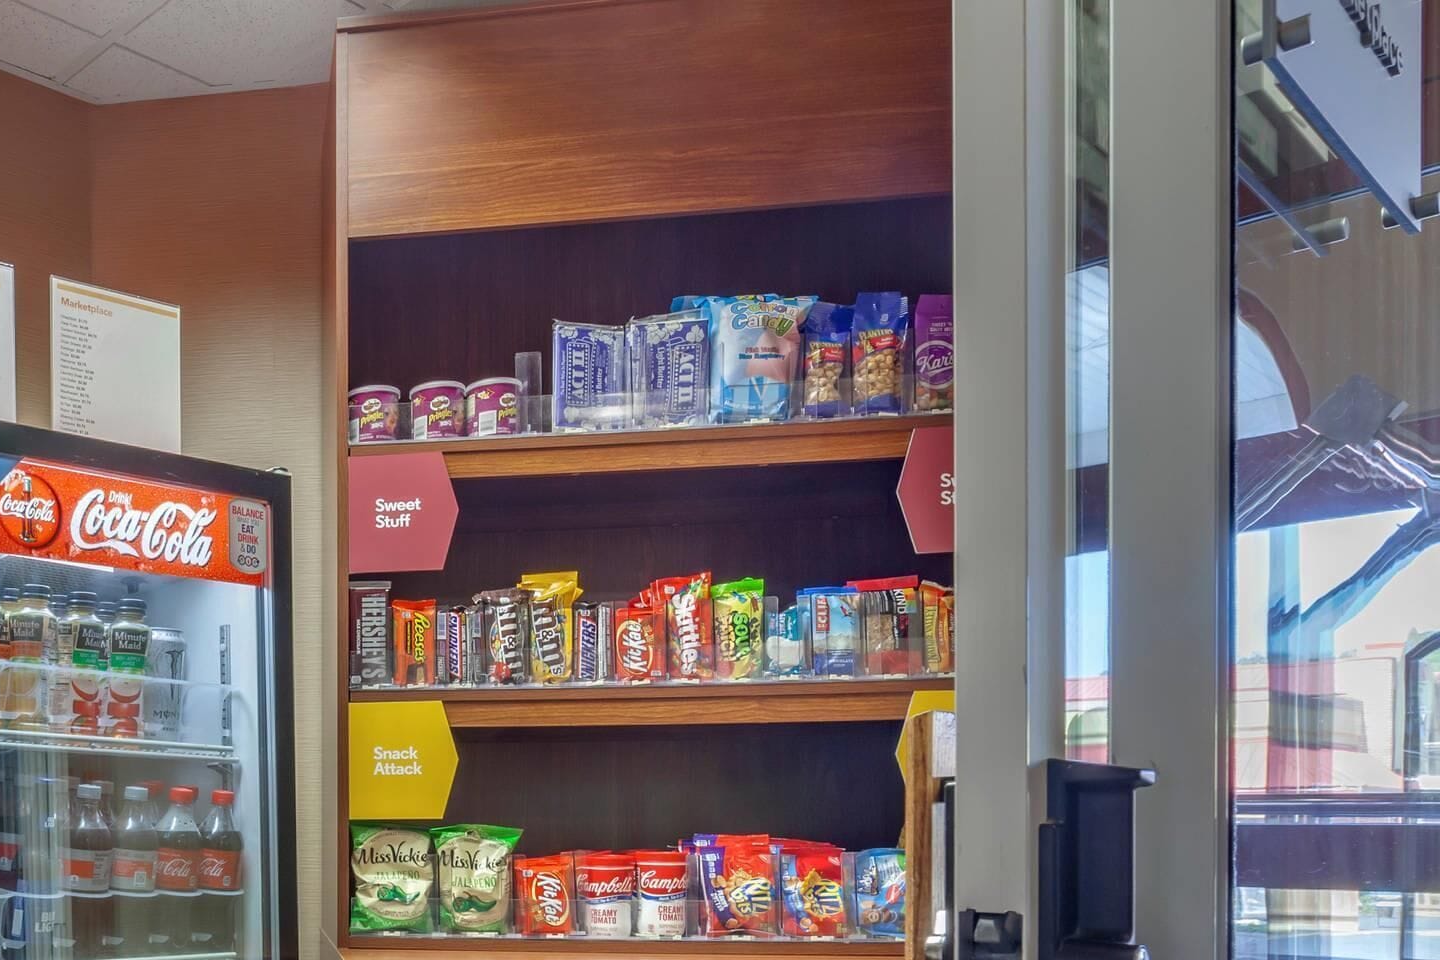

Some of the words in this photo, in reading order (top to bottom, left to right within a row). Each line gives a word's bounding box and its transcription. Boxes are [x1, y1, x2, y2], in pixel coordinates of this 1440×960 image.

[61, 297, 112, 318] Marketplace
[730, 302, 801, 316] Cotton
[731, 312, 794, 338] Candy
[678, 352, 694, 384] ACT
[572, 368, 585, 400] ACT
[656, 365, 665, 389] Butter
[360, 412, 384, 428] Pringles
[429, 410, 453, 425] Pringles
[232, 505, 264, 520] BALANCE
[375, 498, 421, 512] Sweet
[71, 488, 216, 568] Coca-Cola
[375, 514, 411, 528] Stuff
[241, 524, 254, 534] EAT
[238, 533, 259, 544] DRINK
[246, 545, 256, 554] DO
[894, 589, 906, 615] KIND
[115, 631, 147, 643] Minute
[361, 597, 386, 679] HERSHEY'S
[672, 594, 701, 675] Skittles
[118, 640, 142, 650] Maid
[449, 615, 458, 675] SNICKERS
[581, 620, 597, 680] SNICKERS
[373, 747, 418, 760] Snack
[373, 762, 422, 775] Attack
[591, 909, 617, 918] CREAMY
[591, 916, 617, 925] TOMATO
